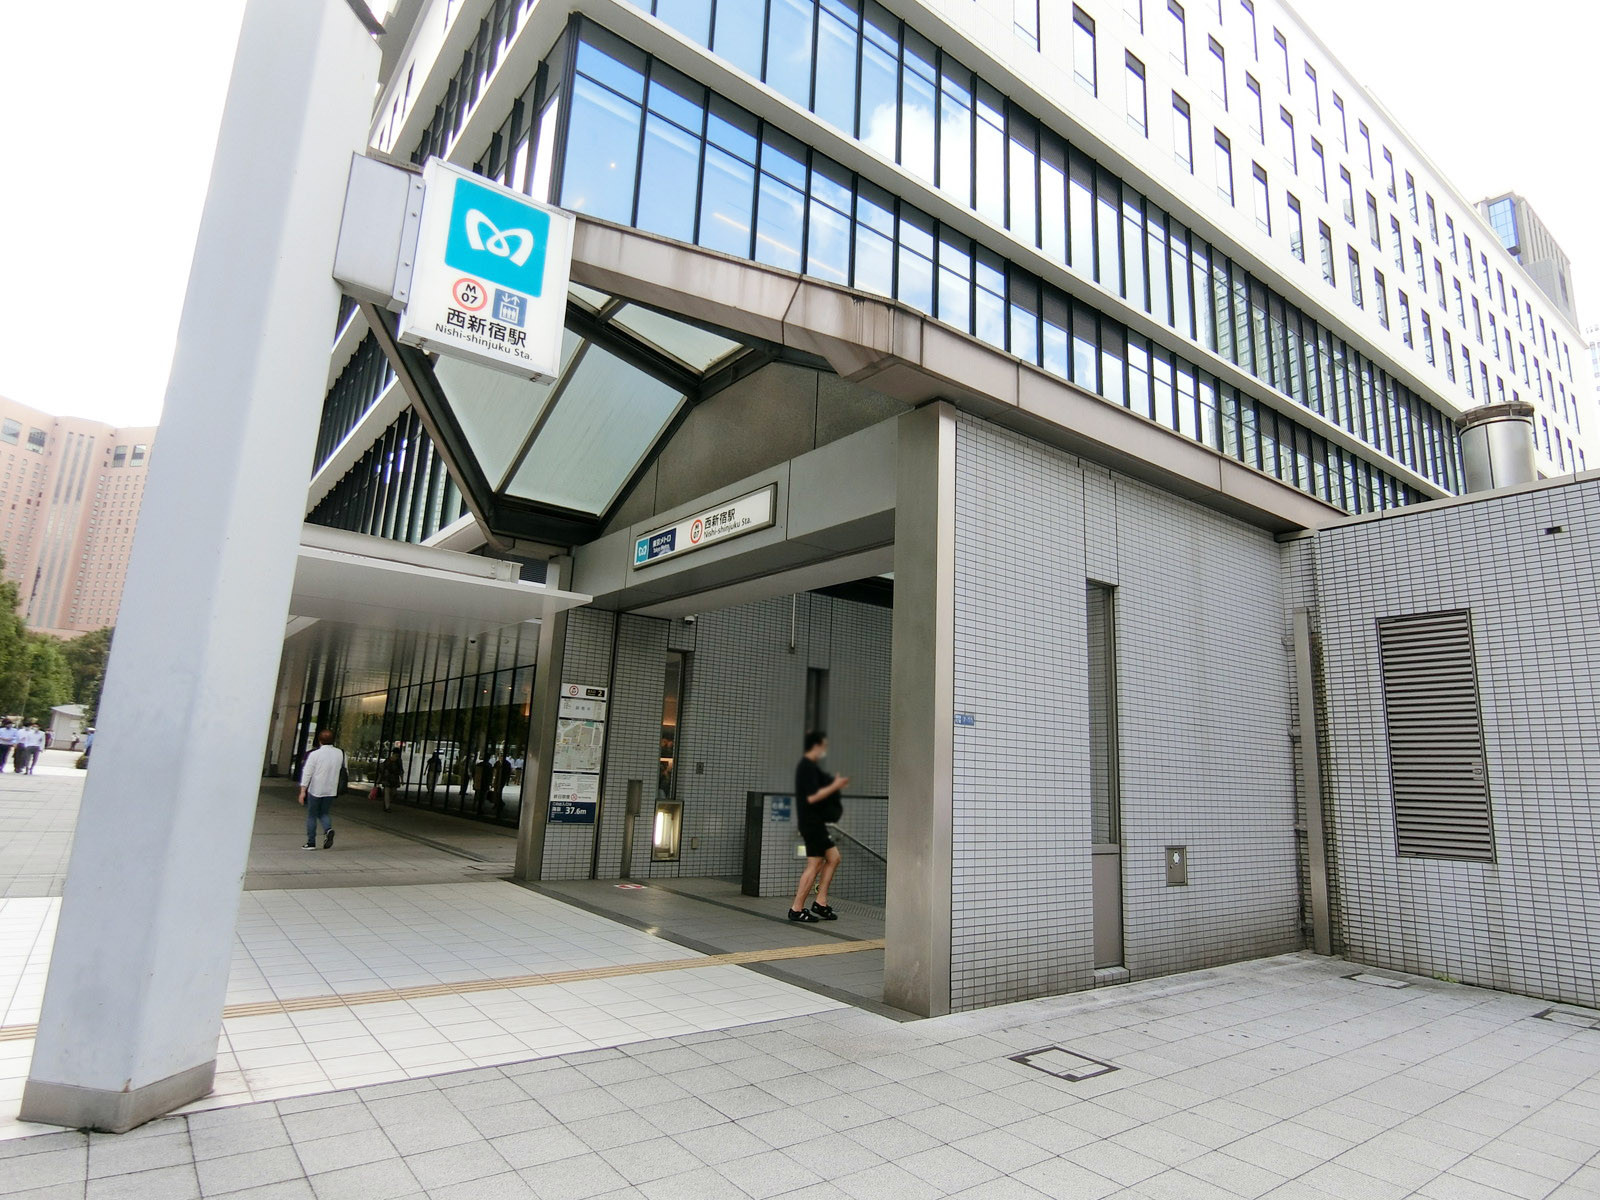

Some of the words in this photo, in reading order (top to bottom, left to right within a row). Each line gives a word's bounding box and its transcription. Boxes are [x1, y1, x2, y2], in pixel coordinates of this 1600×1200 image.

[465, 283, 477, 295] M
[461, 293, 478, 304] 07
[446, 307, 527, 348] 西新宿駅
[435, 323, 511, 354] Nishi-shinjuku
[514, 349, 533, 361] Sta.
[704, 508, 736, 530] 西新宿駅
[703, 521, 741, 539] Nishi-shinjuku
[565, 806, 587, 815] 37.6m
